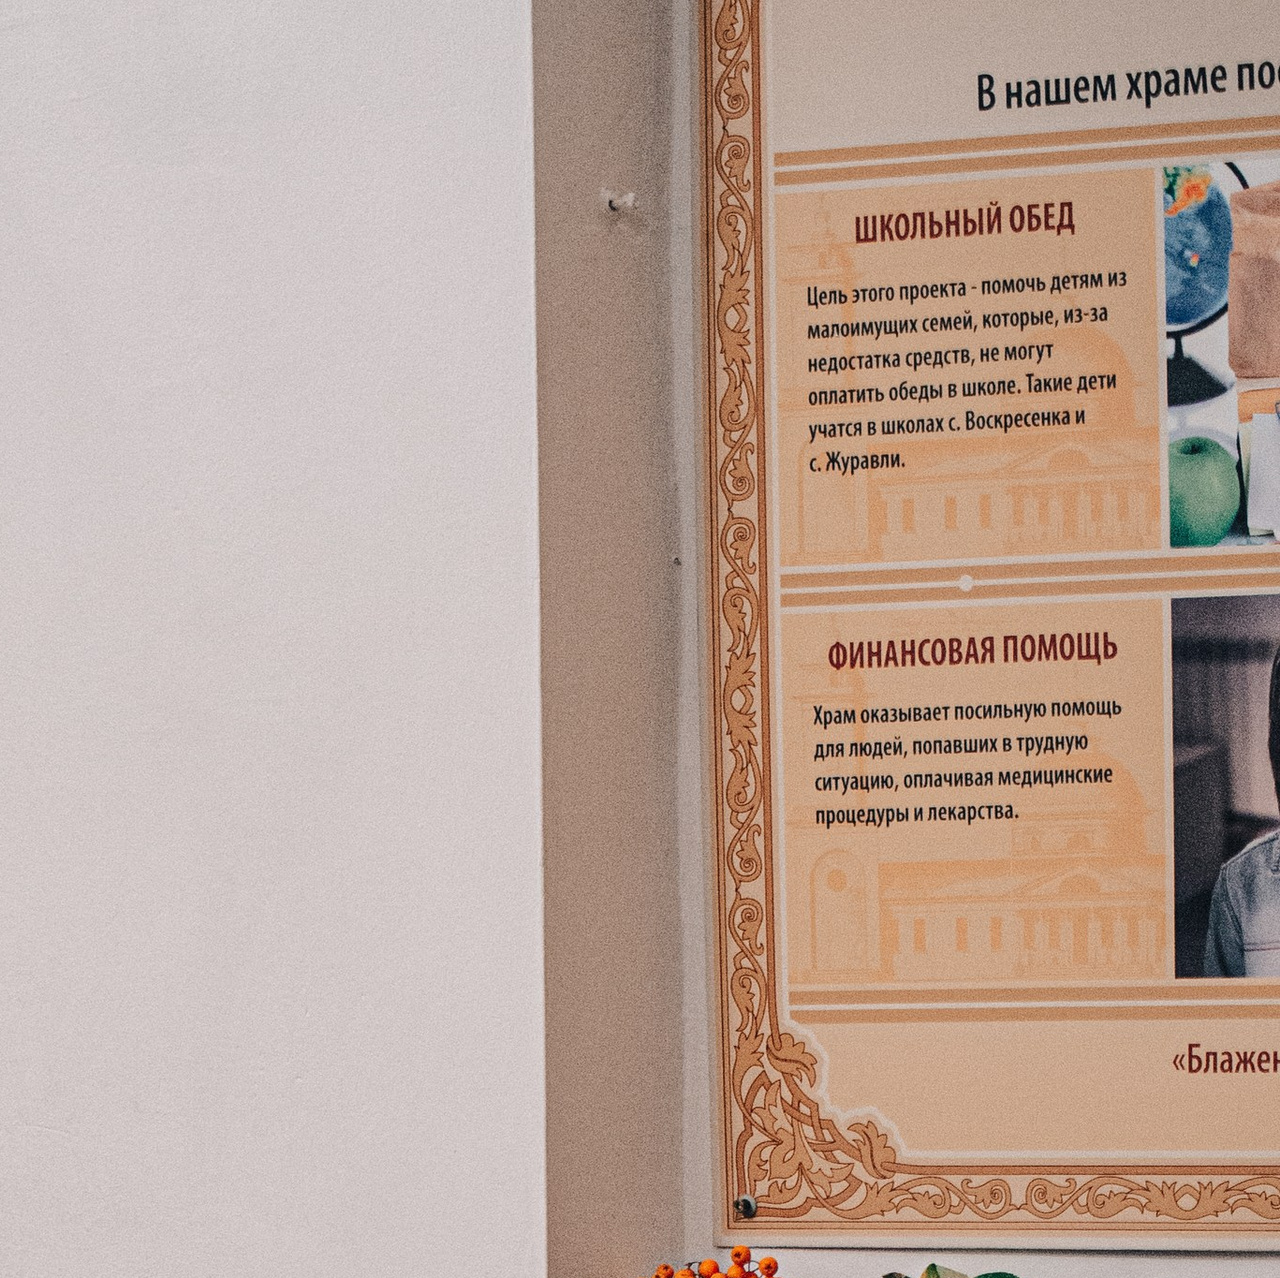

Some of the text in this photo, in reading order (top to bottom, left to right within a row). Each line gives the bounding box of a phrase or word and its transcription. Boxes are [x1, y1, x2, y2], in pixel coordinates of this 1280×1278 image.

[977, 60, 1280, 112] В нашем храме по
[854, 200, 1076, 244] ШКОЛЬНЫЙ ОБЕД
[806, 285, 849, 309] Цель
[851, 286, 896, 304] этого
[898, 281, 967, 305] проекта
[980, 276, 1047, 295] помочь
[1049, 272, 1104, 294] детям
[1107, 270, 1128, 287] из
[807, 306, 1109, 341] малоимущих семей, которые, из-за
[807, 343, 1054, 375] недостатка средств, не могут
[807, 372, 1117, 407] оплатить обеды в школе. Такие дети
[808, 409, 1086, 444] учатся в школах с. Воскресенка и
[808, 451, 906, 476] с. Журавли.
[827, 631, 1118, 671] ФИНАНСОВАЯ ПОМОЩЬ
[813, 700, 1123, 730] Храм оказывает посильную помощь
[813, 734, 1089, 762] для людей, попавших в трудную
[814, 767, 1114, 796] ситуацию, оплачивая медицинские
[815, 803, 1020, 829] процедуры и лекарства.
